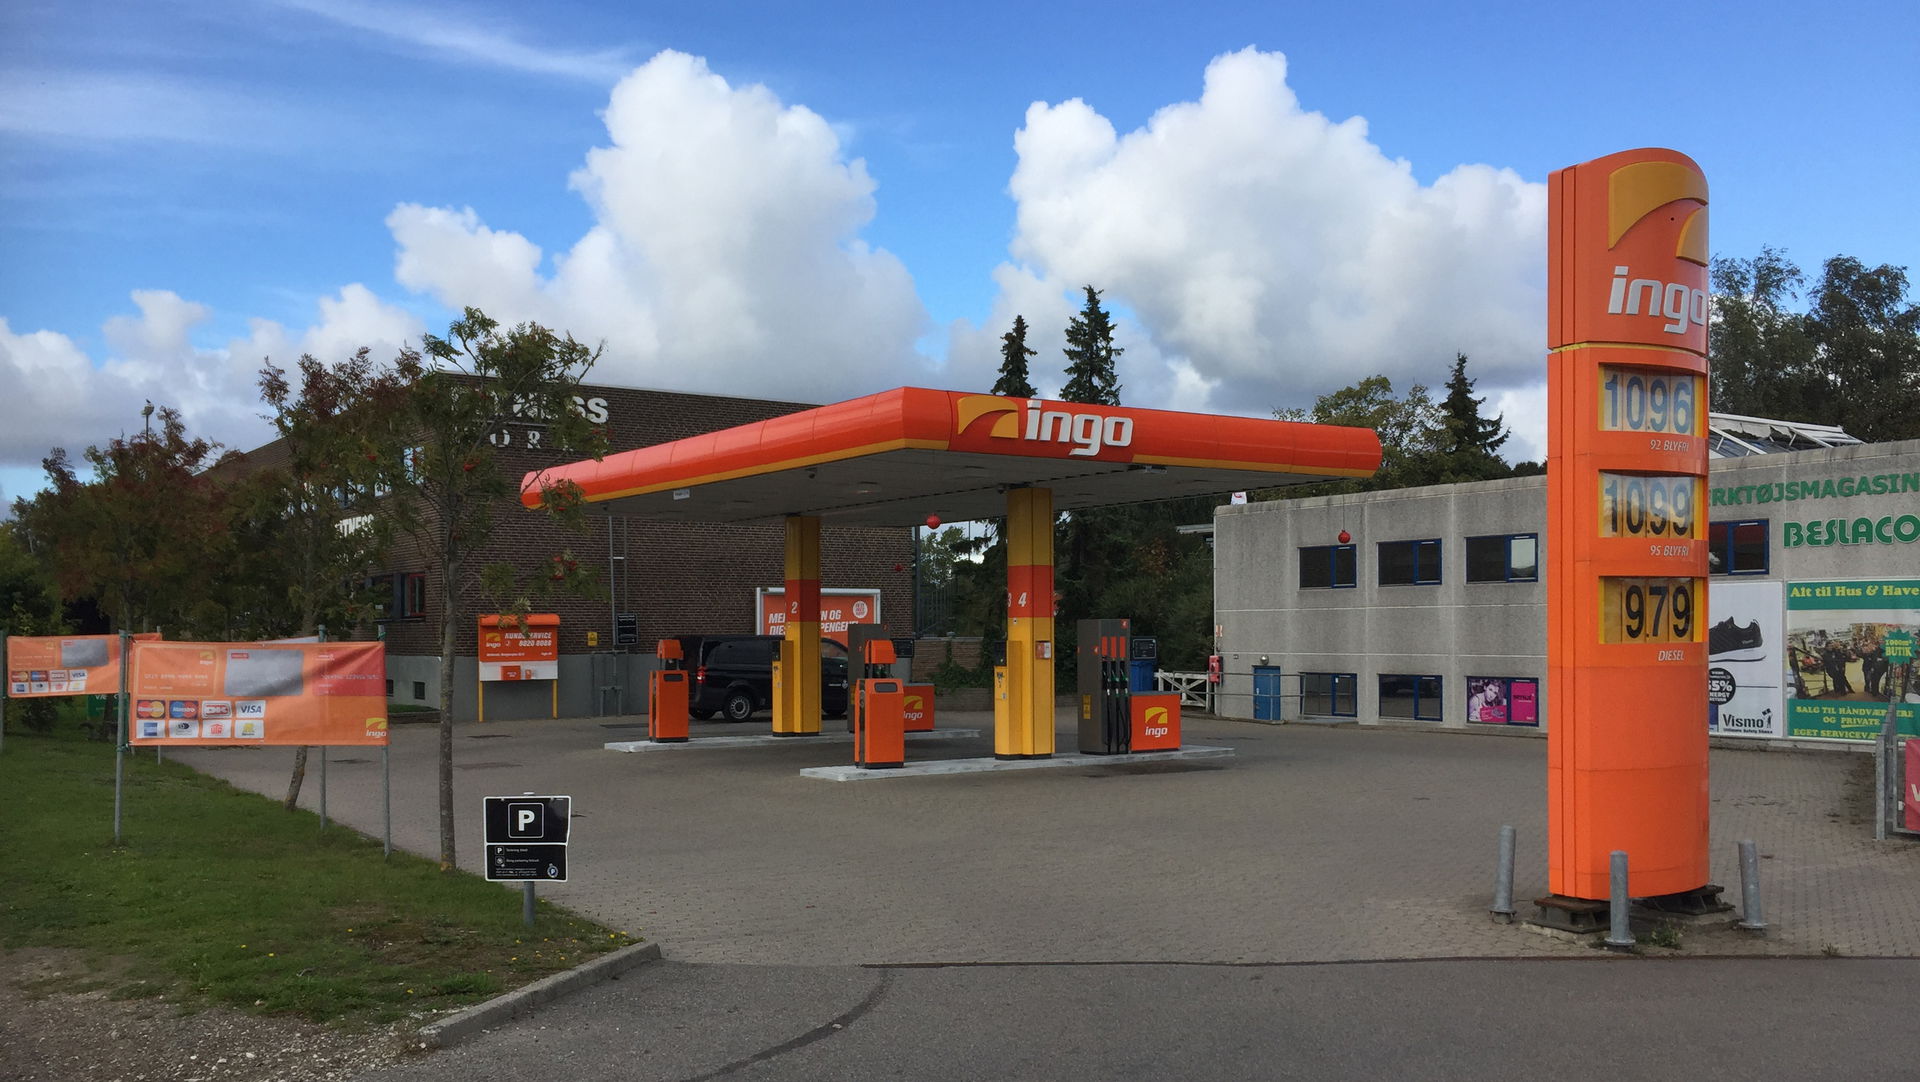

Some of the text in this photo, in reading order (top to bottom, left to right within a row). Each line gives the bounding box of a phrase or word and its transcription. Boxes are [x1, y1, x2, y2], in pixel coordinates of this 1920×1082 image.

[1607, 266, 1707, 334] ingo
[1024, 400, 1133, 456] ingo
[1650, 440, 1661, 450] 92
[1709, 472, 1920, 507] RKTØJSMAGASIN
[1650, 545, 1661, 556] 95
[1791, 587, 1811, 597] Alt
[1815, 587, 1831, 596] til
[1835, 586, 1862, 597] Hus
[1866, 585, 1879, 596] &
[1018, 592, 1027, 607] 4
[791, 601, 798, 614] 2
[829, 609, 842, 620] OG
[1658, 651, 1685, 662] DIESEL
[1885, 646, 1912, 657] BUTIK
[240, 705, 262, 714] VISA
[1796, 706, 1820, 714] SALG
[1822, 706, 1837, 714] TIL
[1722, 713, 1764, 729] Vismo
[1823, 716, 1881, 726] OG PRIVATE
[366, 729, 387, 739] ingo
[1145, 726, 1168, 738] ingo
[1793, 728, 1819, 736] EGET
[518, 809, 535, 832] P
